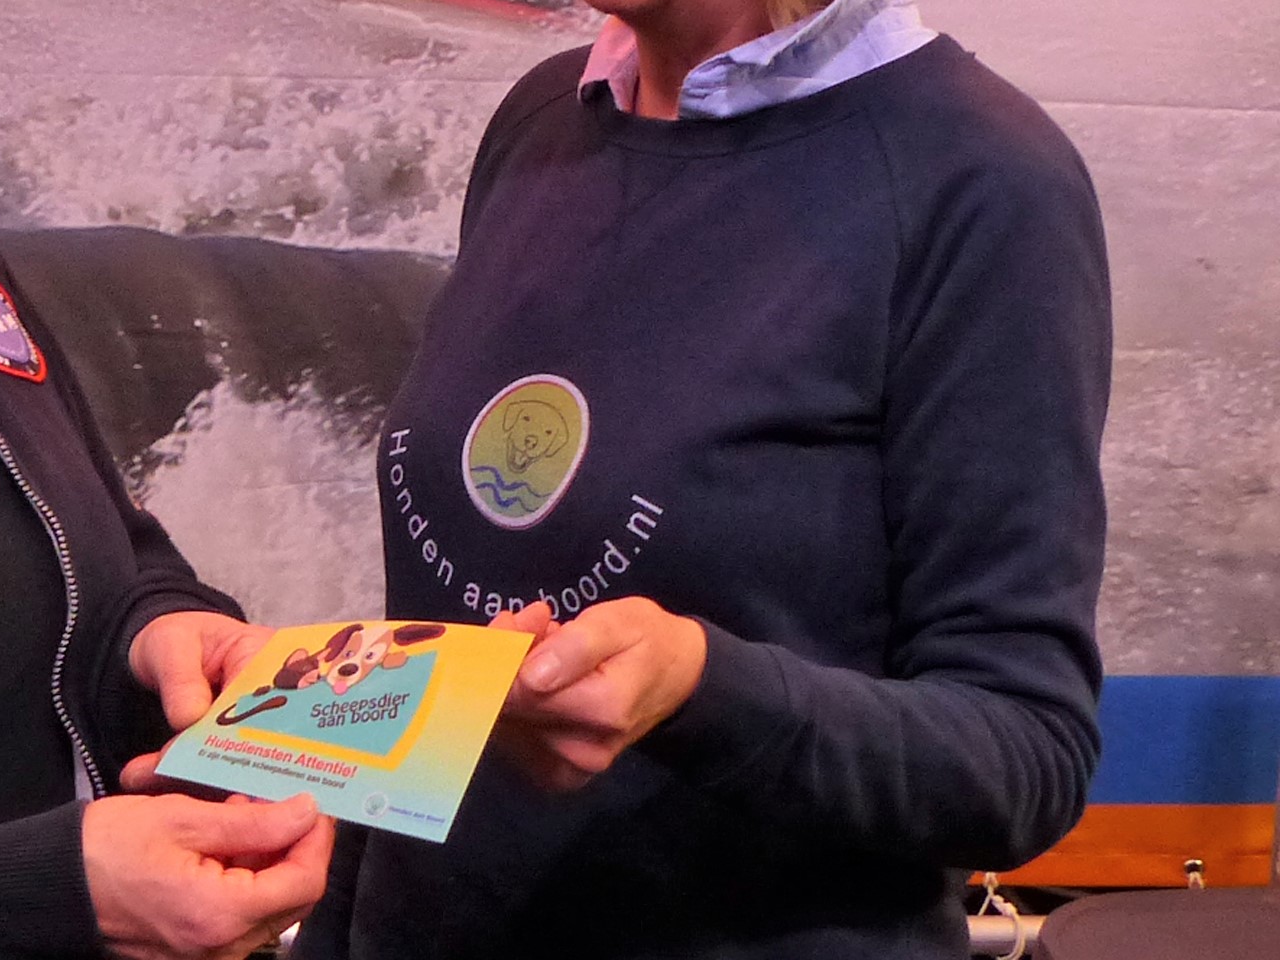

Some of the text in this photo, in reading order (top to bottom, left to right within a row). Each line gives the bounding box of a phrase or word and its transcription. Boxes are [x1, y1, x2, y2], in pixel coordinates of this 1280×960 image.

[388, 428, 454, 586] Honden
[310, 692, 410, 718] Scheepsdier
[317, 704, 399, 728] aan boord
[204, 734, 358, 779] Hulpdiensten Attentie!
